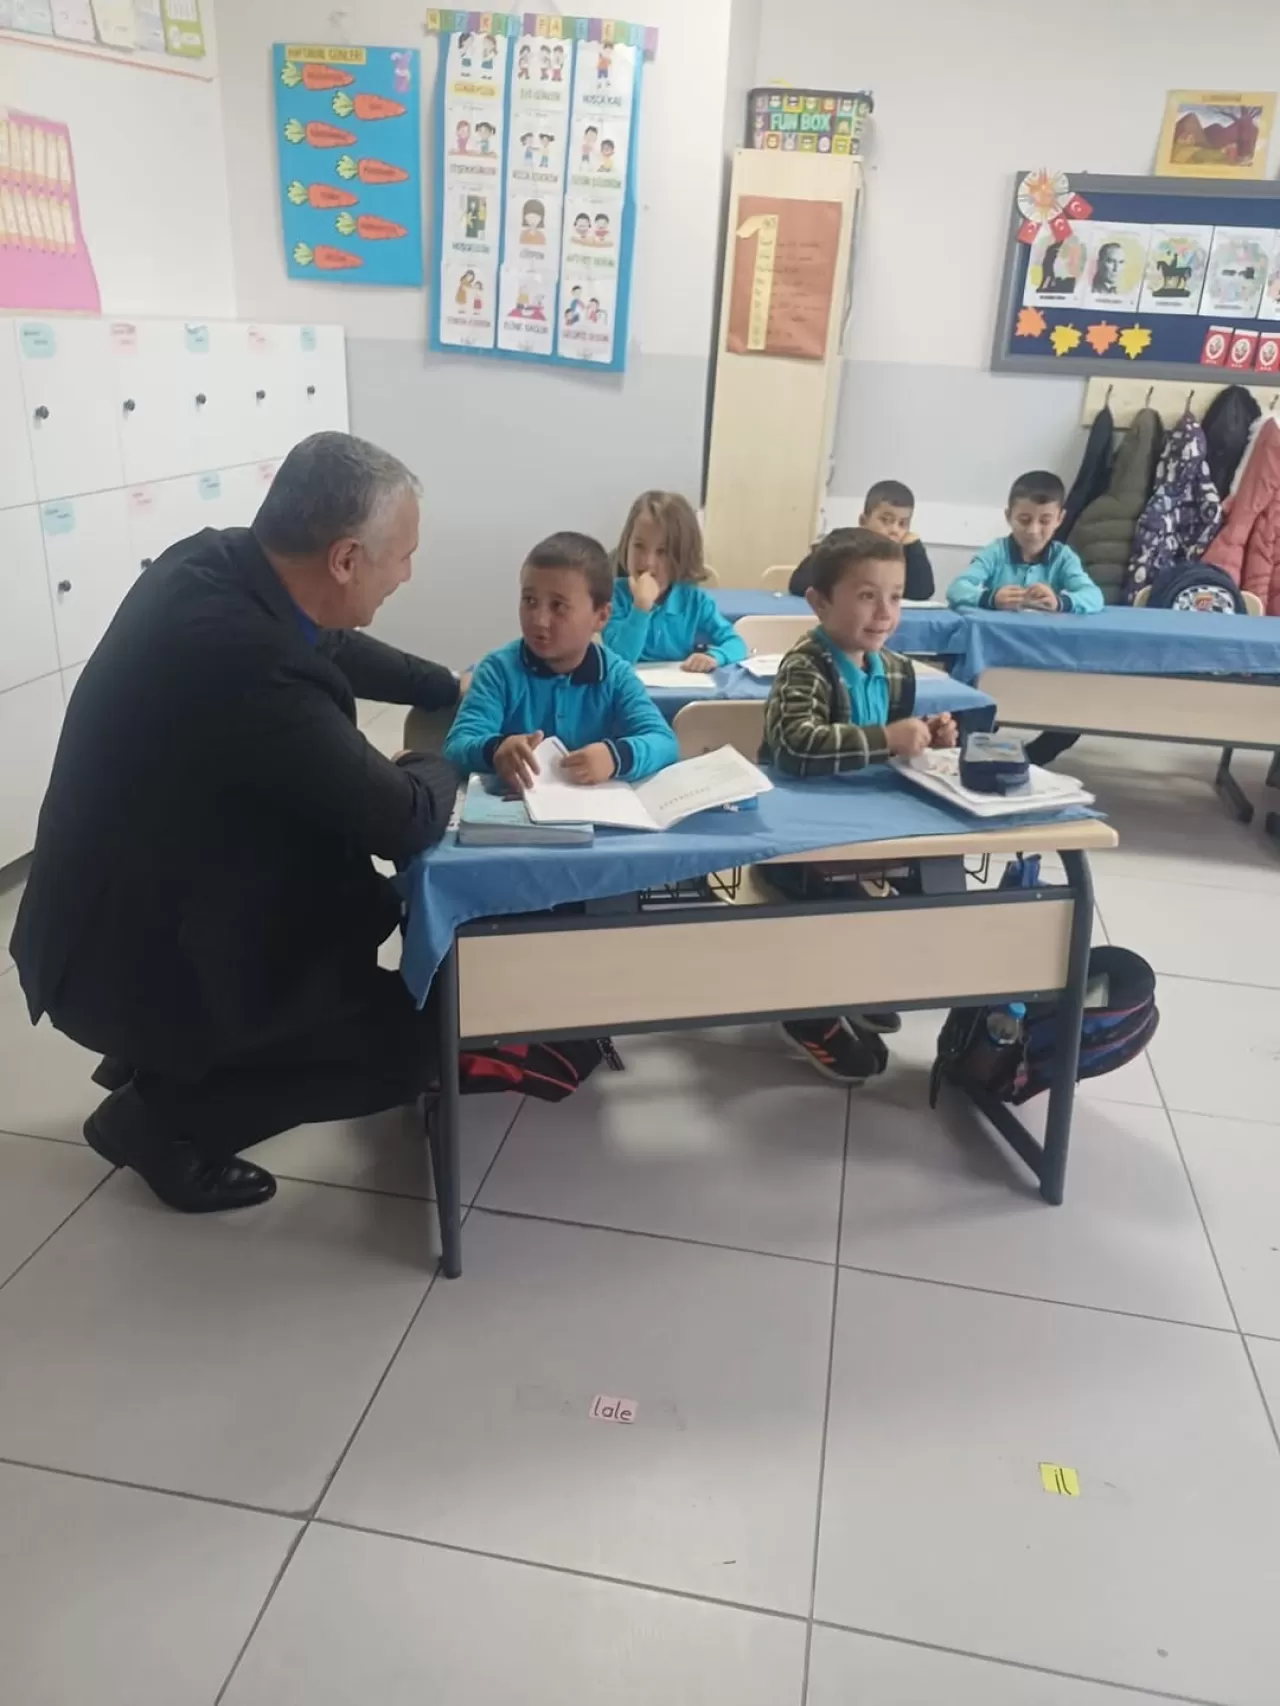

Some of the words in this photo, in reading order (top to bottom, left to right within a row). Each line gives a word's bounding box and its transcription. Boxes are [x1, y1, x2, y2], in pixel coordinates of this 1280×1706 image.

[770, 113, 799, 131] FUN
[800, 113, 832, 132] BOX
[594, 1396, 633, 1421] lale
[1053, 1467, 1073, 1496] il
